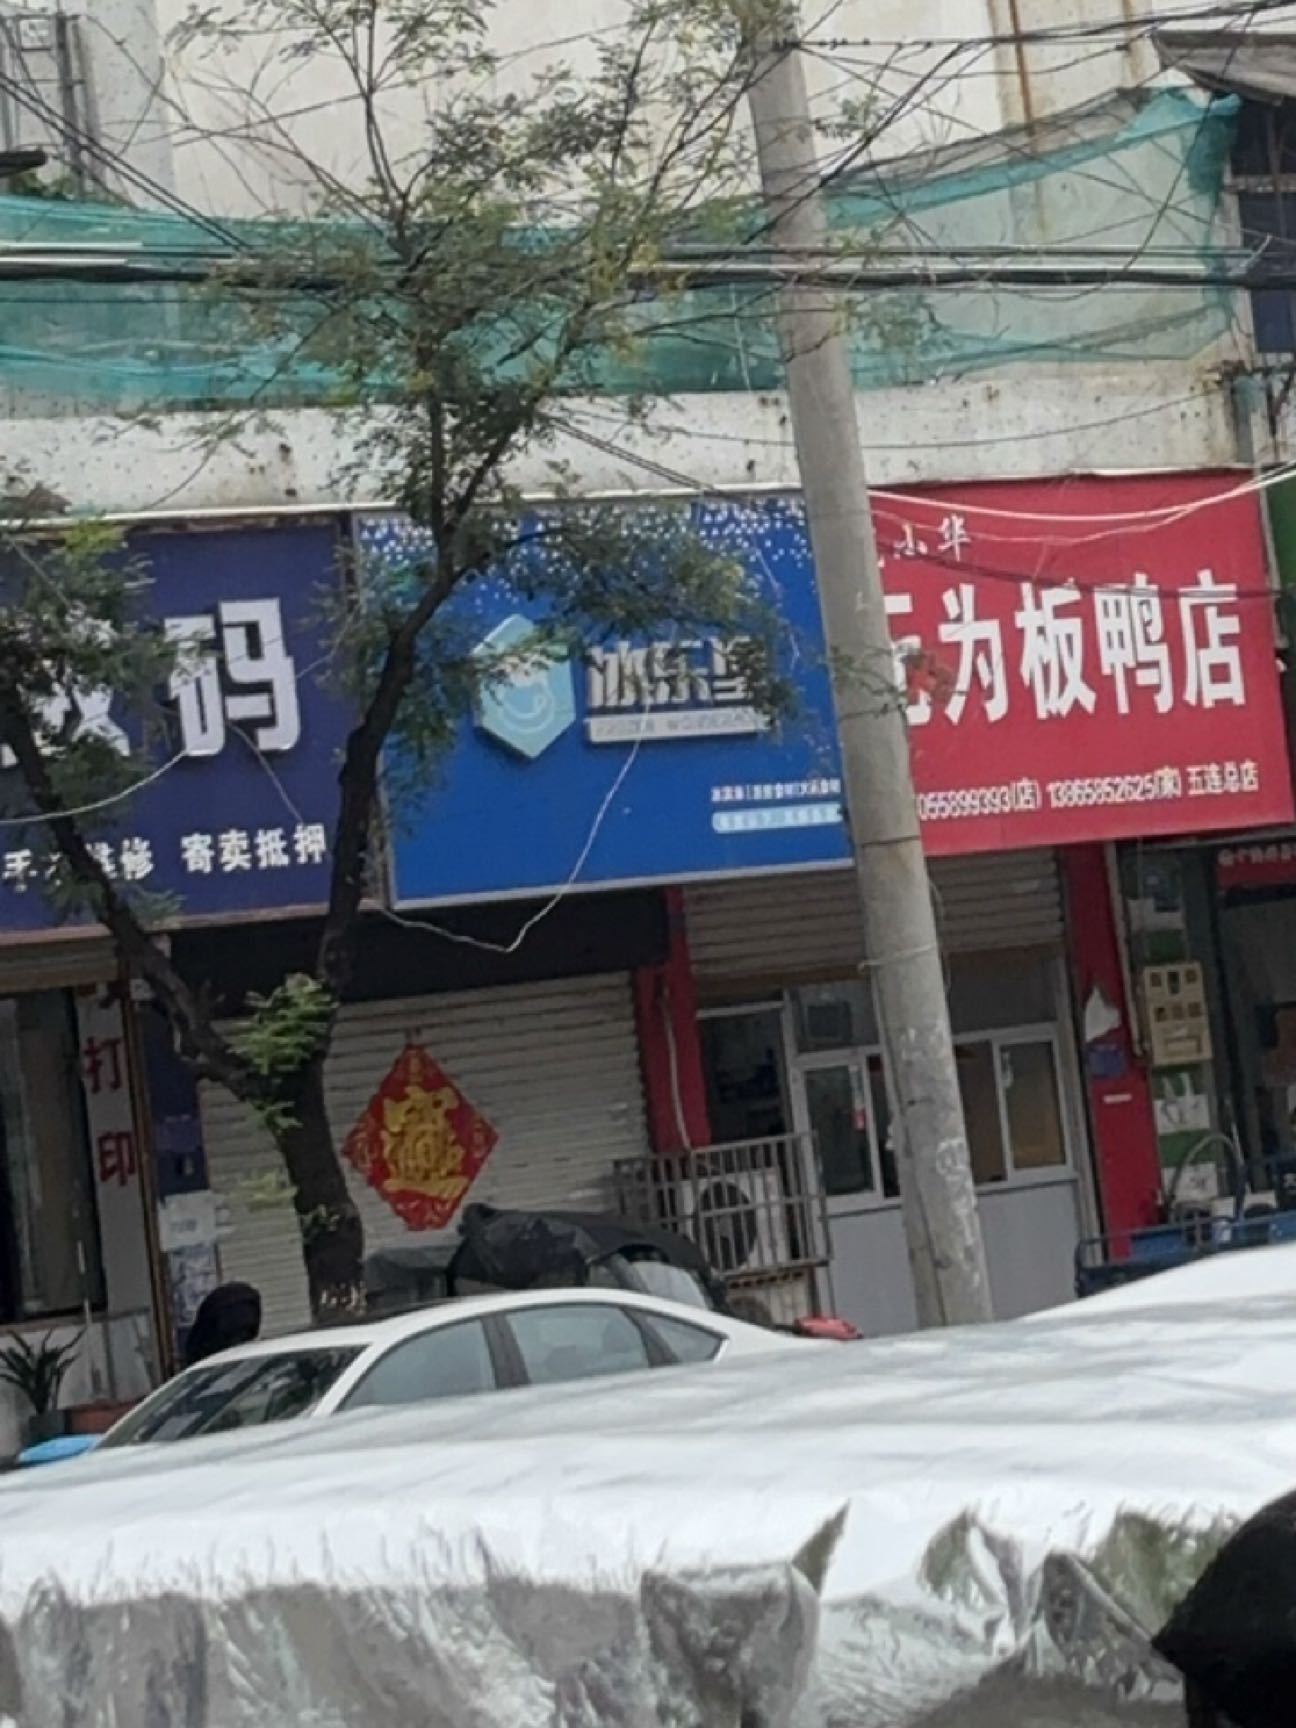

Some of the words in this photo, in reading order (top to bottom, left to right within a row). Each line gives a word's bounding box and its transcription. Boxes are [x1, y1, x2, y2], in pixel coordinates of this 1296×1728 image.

[181, 823, 326, 873] 寄卖抵押
[82, 1036, 136, 1187] 打印
